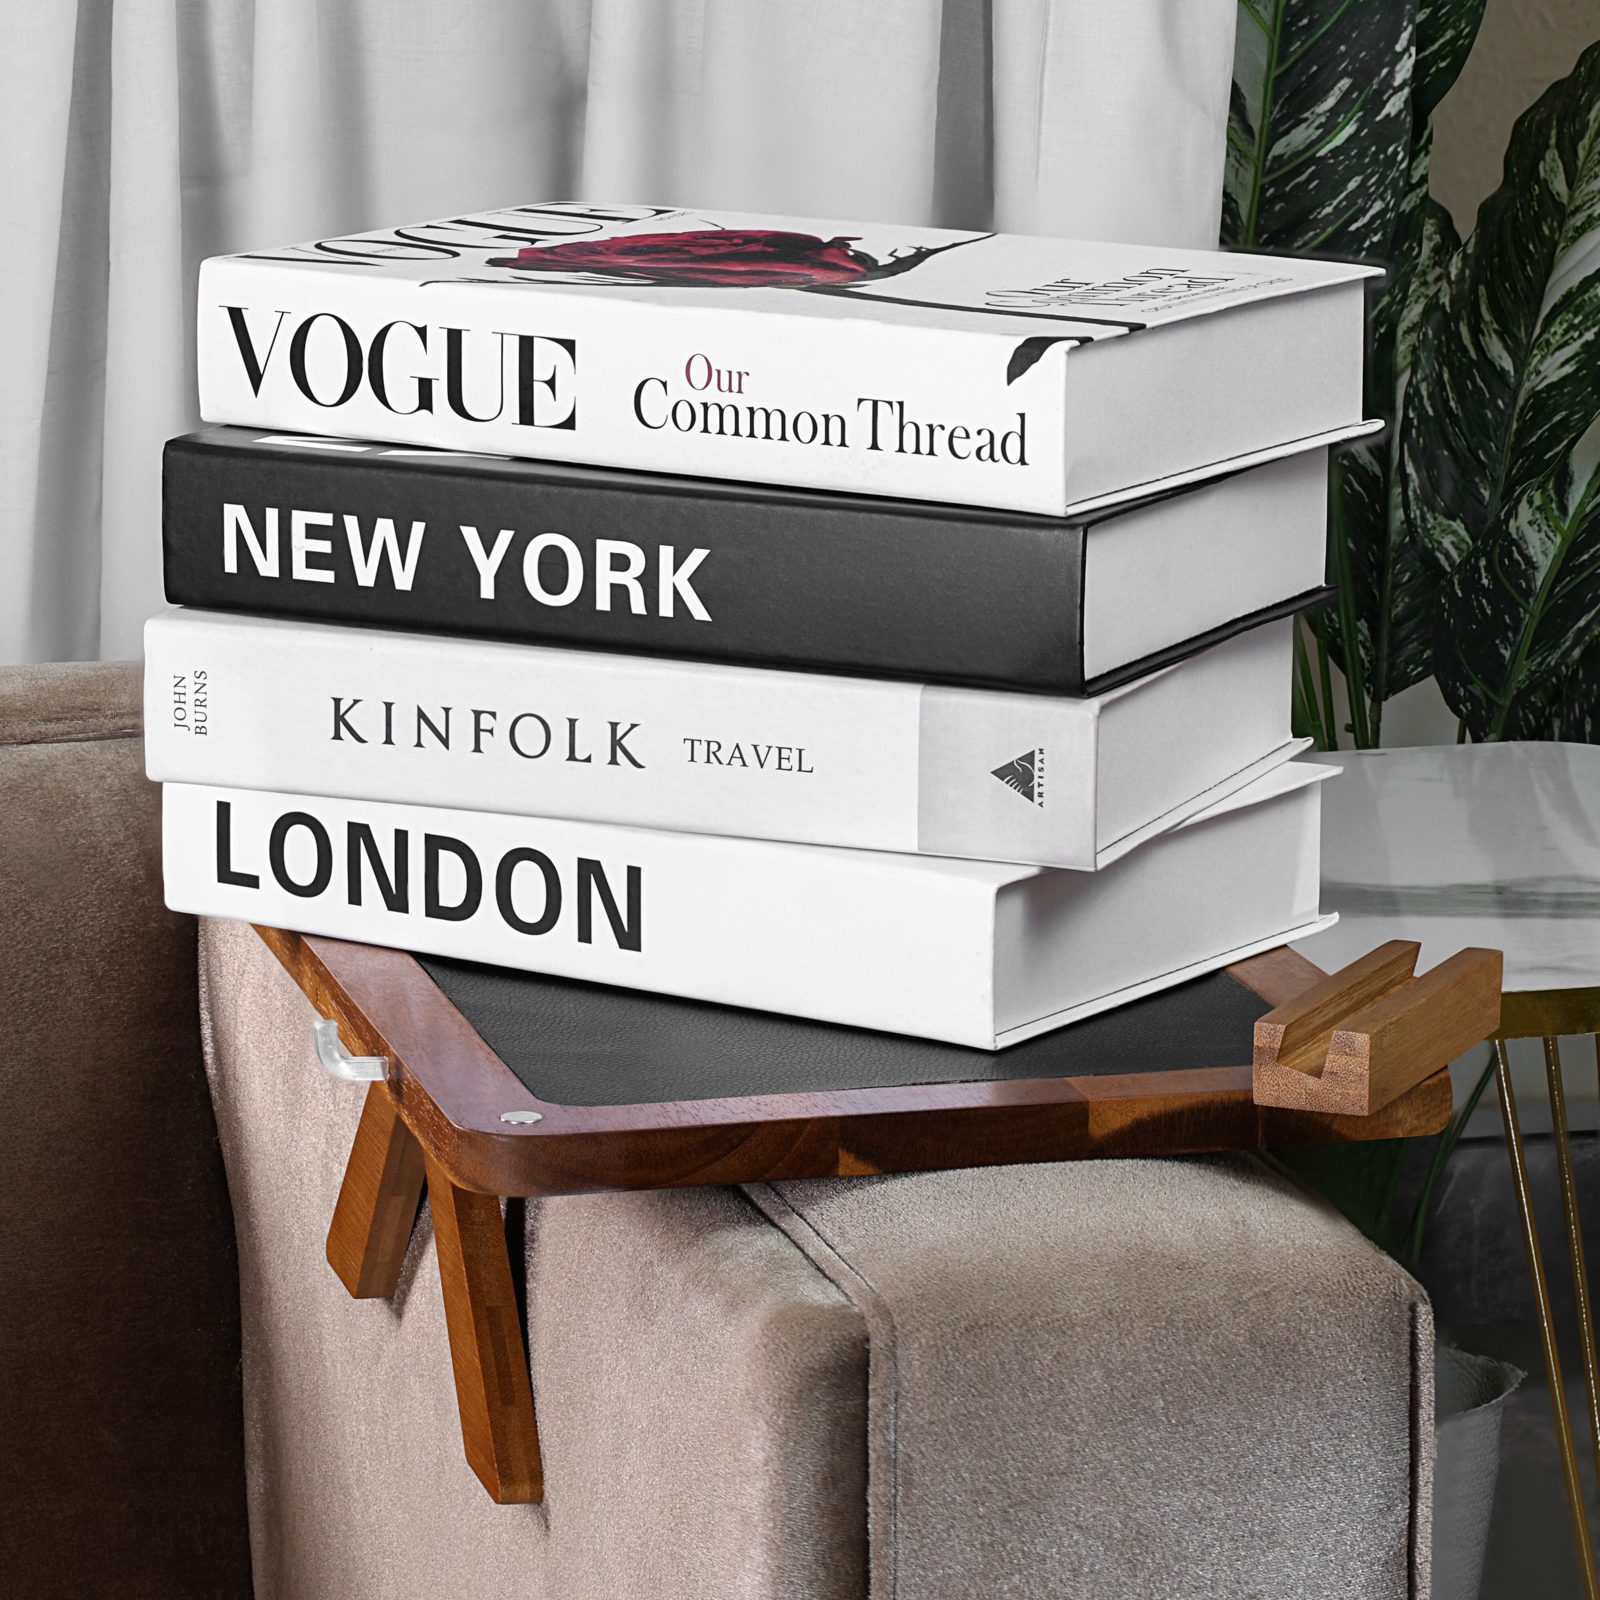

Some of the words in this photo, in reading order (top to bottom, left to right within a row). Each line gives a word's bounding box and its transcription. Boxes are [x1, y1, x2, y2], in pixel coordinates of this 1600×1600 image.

[224, 202, 676, 267] VOGUE
[986, 278, 1094, 297] Our
[1061, 276, 1236, 306] Thread
[219, 306, 576, 430] VOGUE
[685, 354, 749, 394] Our
[633, 378, 849, 447] Common
[857, 398, 1030, 466] Thread
[223, 503, 426, 591] NEW
[460, 525, 713, 622] YORK
[173, 674, 190, 731] JOHN
[194, 670, 208, 736] BURNS
[330, 697, 646, 769] KINFOLK
[683, 738, 814, 774] TRAVEL
[1037, 747, 1045, 808] ARTISAN
[216, 801, 642, 953] LONDON
